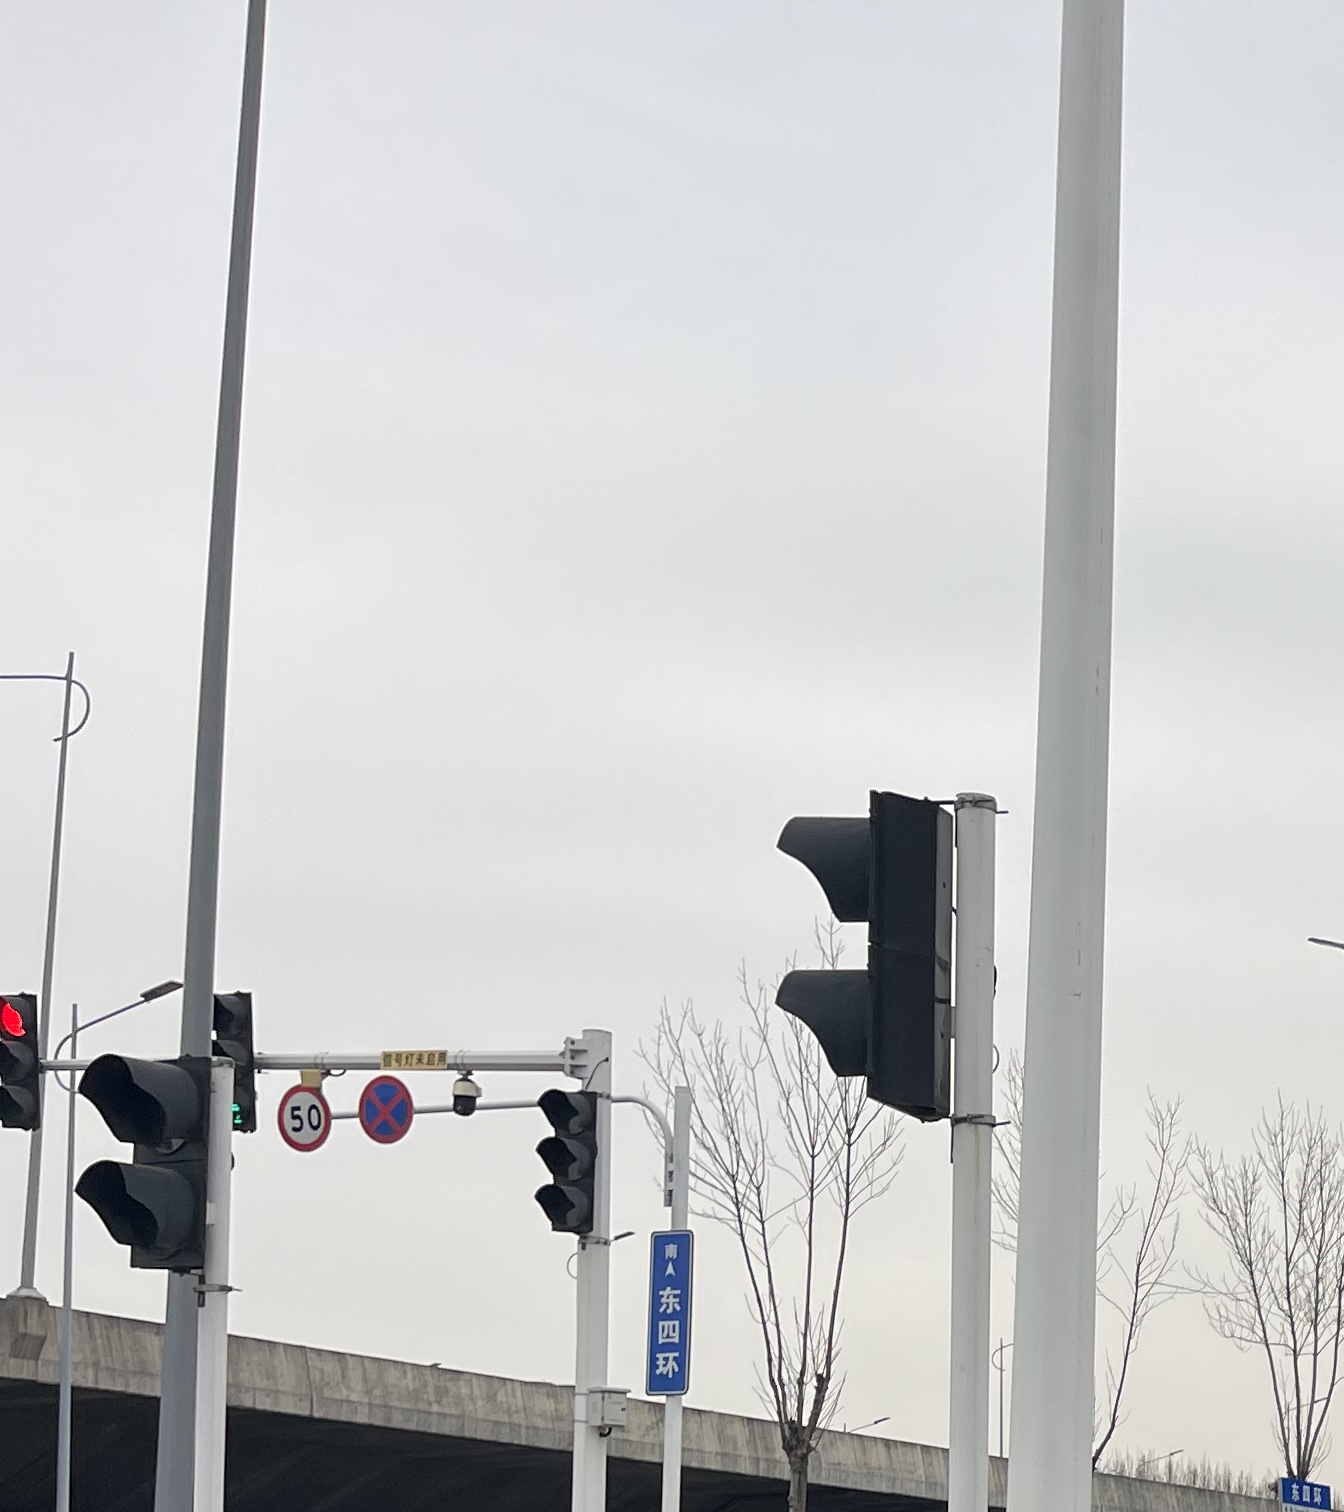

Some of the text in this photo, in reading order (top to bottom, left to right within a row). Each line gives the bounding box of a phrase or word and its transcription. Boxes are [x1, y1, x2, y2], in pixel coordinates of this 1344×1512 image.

[291, 1104, 321, 1132] 50
[665, 1243, 678, 1259] 南
[656, 1286, 681, 1378] 东四环
[1291, 1482, 1322, 1506] 东四环
